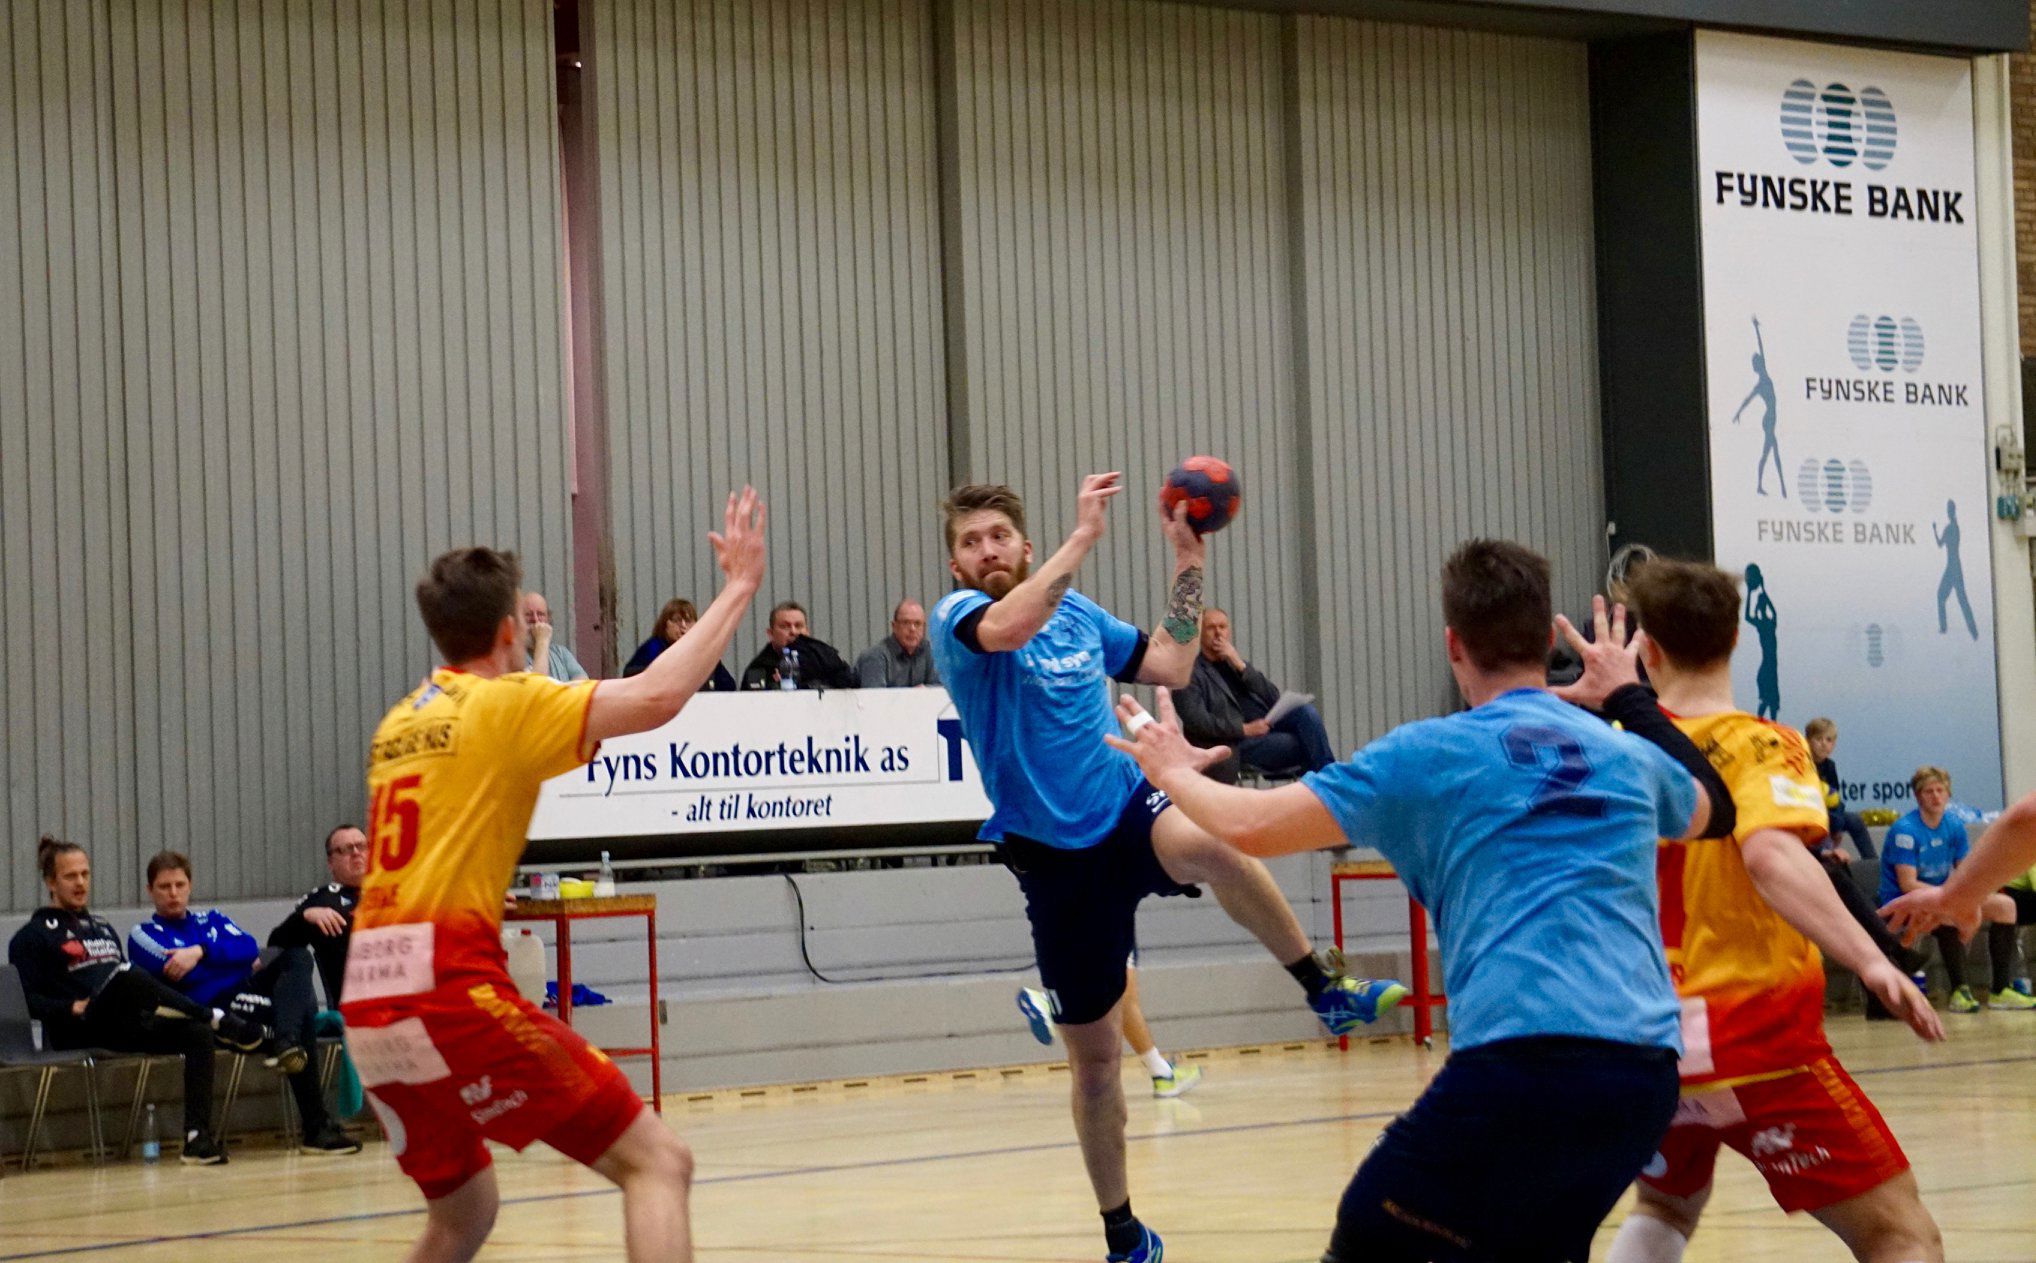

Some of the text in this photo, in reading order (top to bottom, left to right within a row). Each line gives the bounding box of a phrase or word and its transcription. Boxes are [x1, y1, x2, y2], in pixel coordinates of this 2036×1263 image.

[1715, 171, 1964, 224] FYNSKE BANK
[1805, 377, 1969, 407] FYNSKE BANK
[1757, 520, 1916, 545] FYNSKE BANK
[669, 735, 870, 780] Kontorteknik
[880, 744, 910, 773] as
[1498, 722, 1607, 819] 2
[1841, 777, 1911, 804] ter spor
[686, 797, 712, 823] alt
[718, 794, 740, 821] til
[746, 794, 833, 820] kontoret
